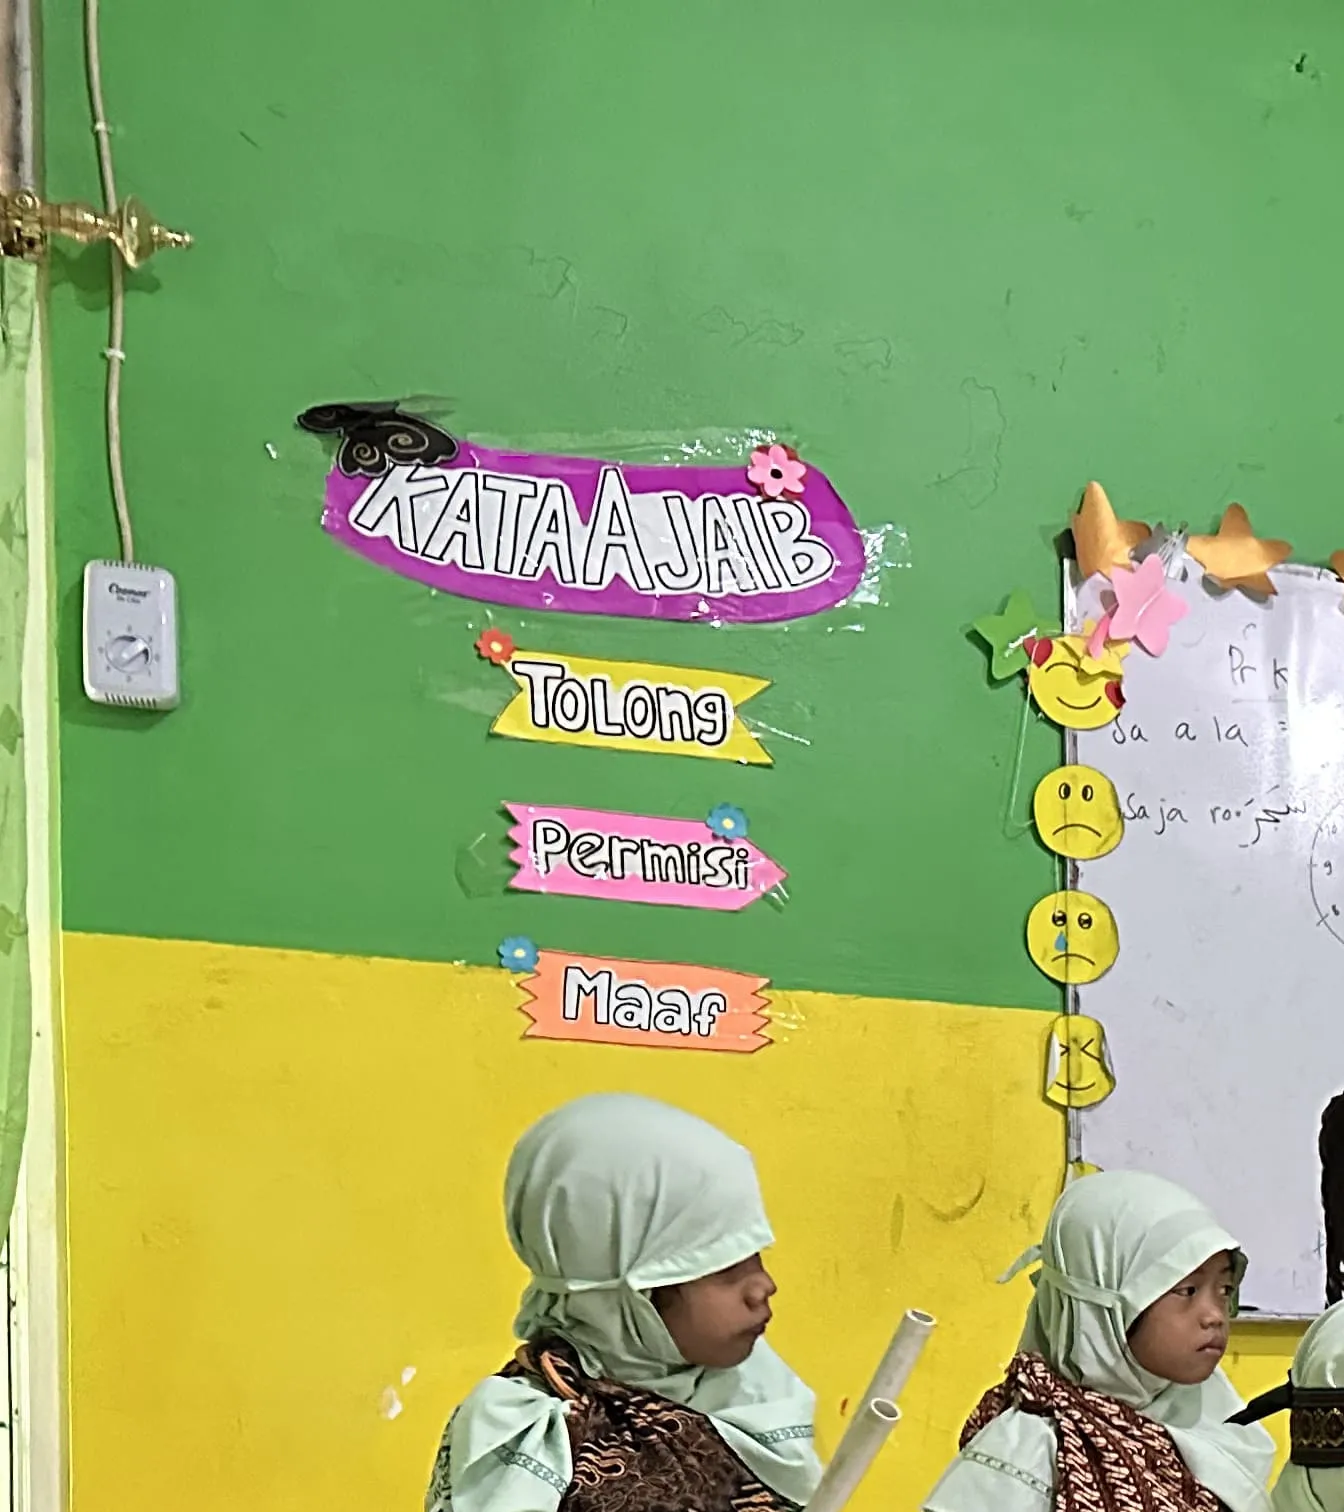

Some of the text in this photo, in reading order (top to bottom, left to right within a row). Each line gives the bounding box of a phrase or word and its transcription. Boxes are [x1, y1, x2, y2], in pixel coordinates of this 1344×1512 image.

[353, 463, 834, 593] KATA AJAIB
[532, 818, 750, 889] Permisi
[562, 966, 727, 1037] Maaf
